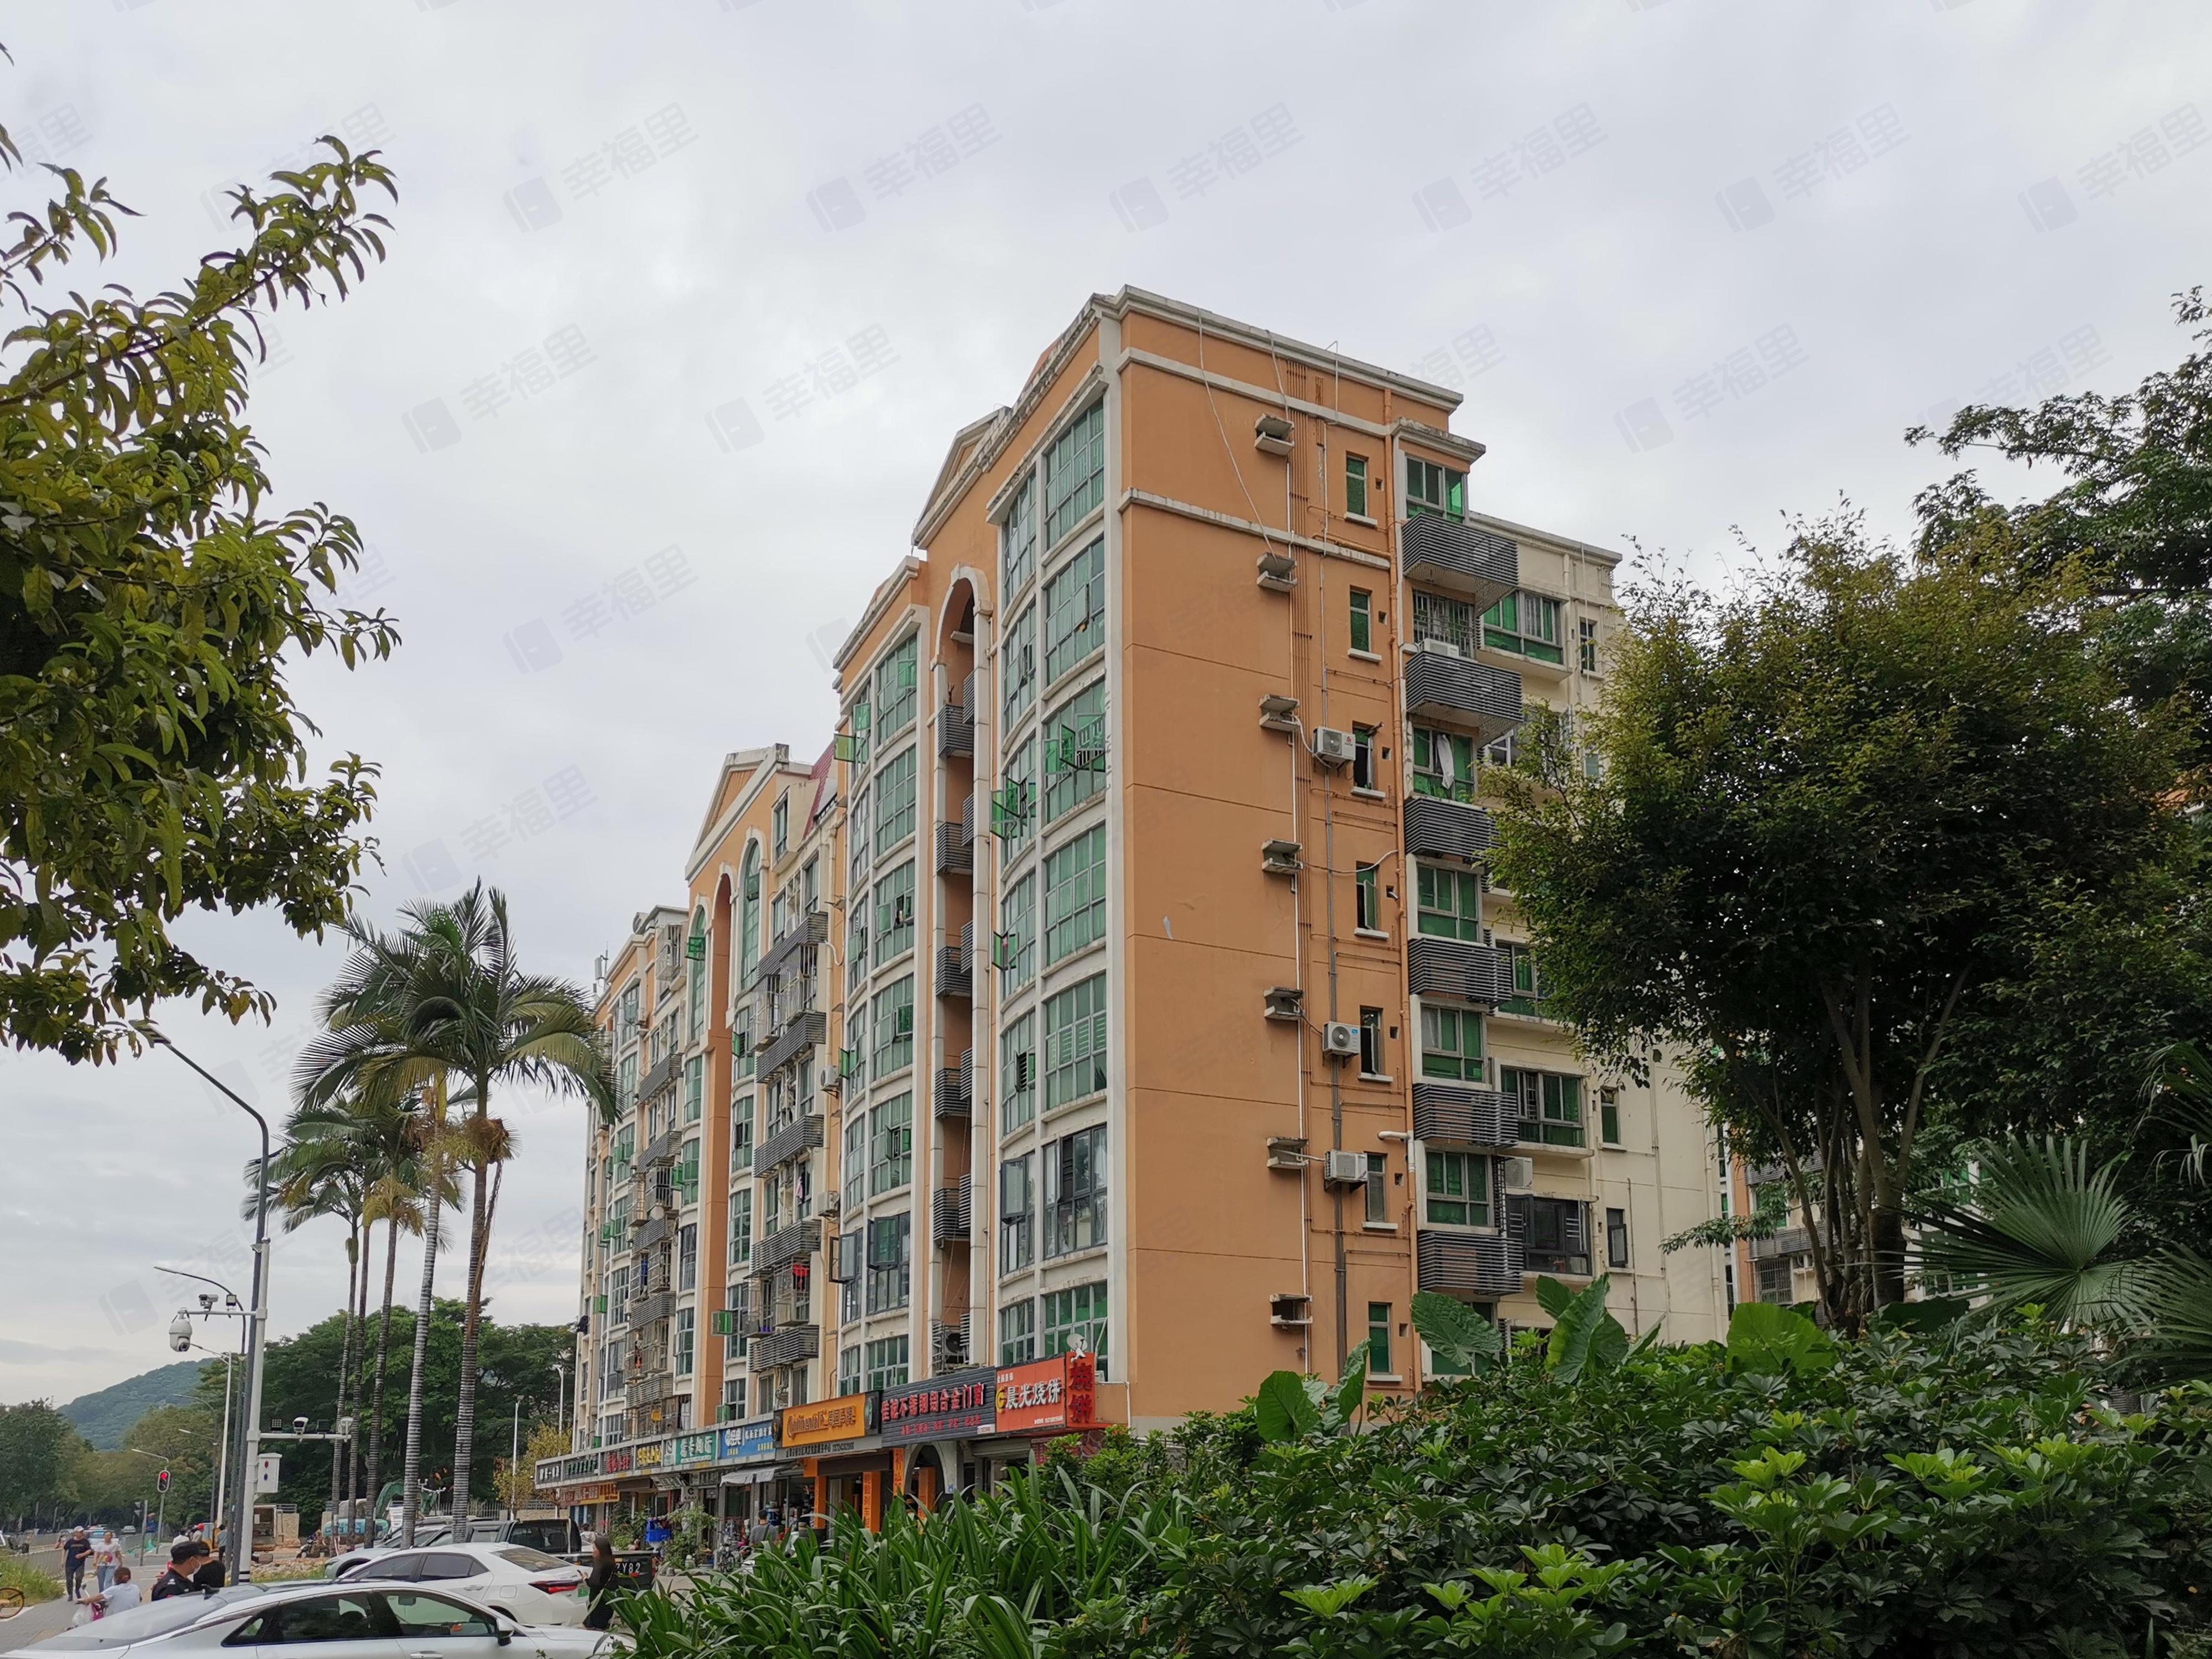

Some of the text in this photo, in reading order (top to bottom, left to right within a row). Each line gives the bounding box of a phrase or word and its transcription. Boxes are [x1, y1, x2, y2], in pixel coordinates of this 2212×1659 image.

[1005, 1378, 1062, 1410] 晨光烧饼
[787, 1411, 821, 1440] Continental
